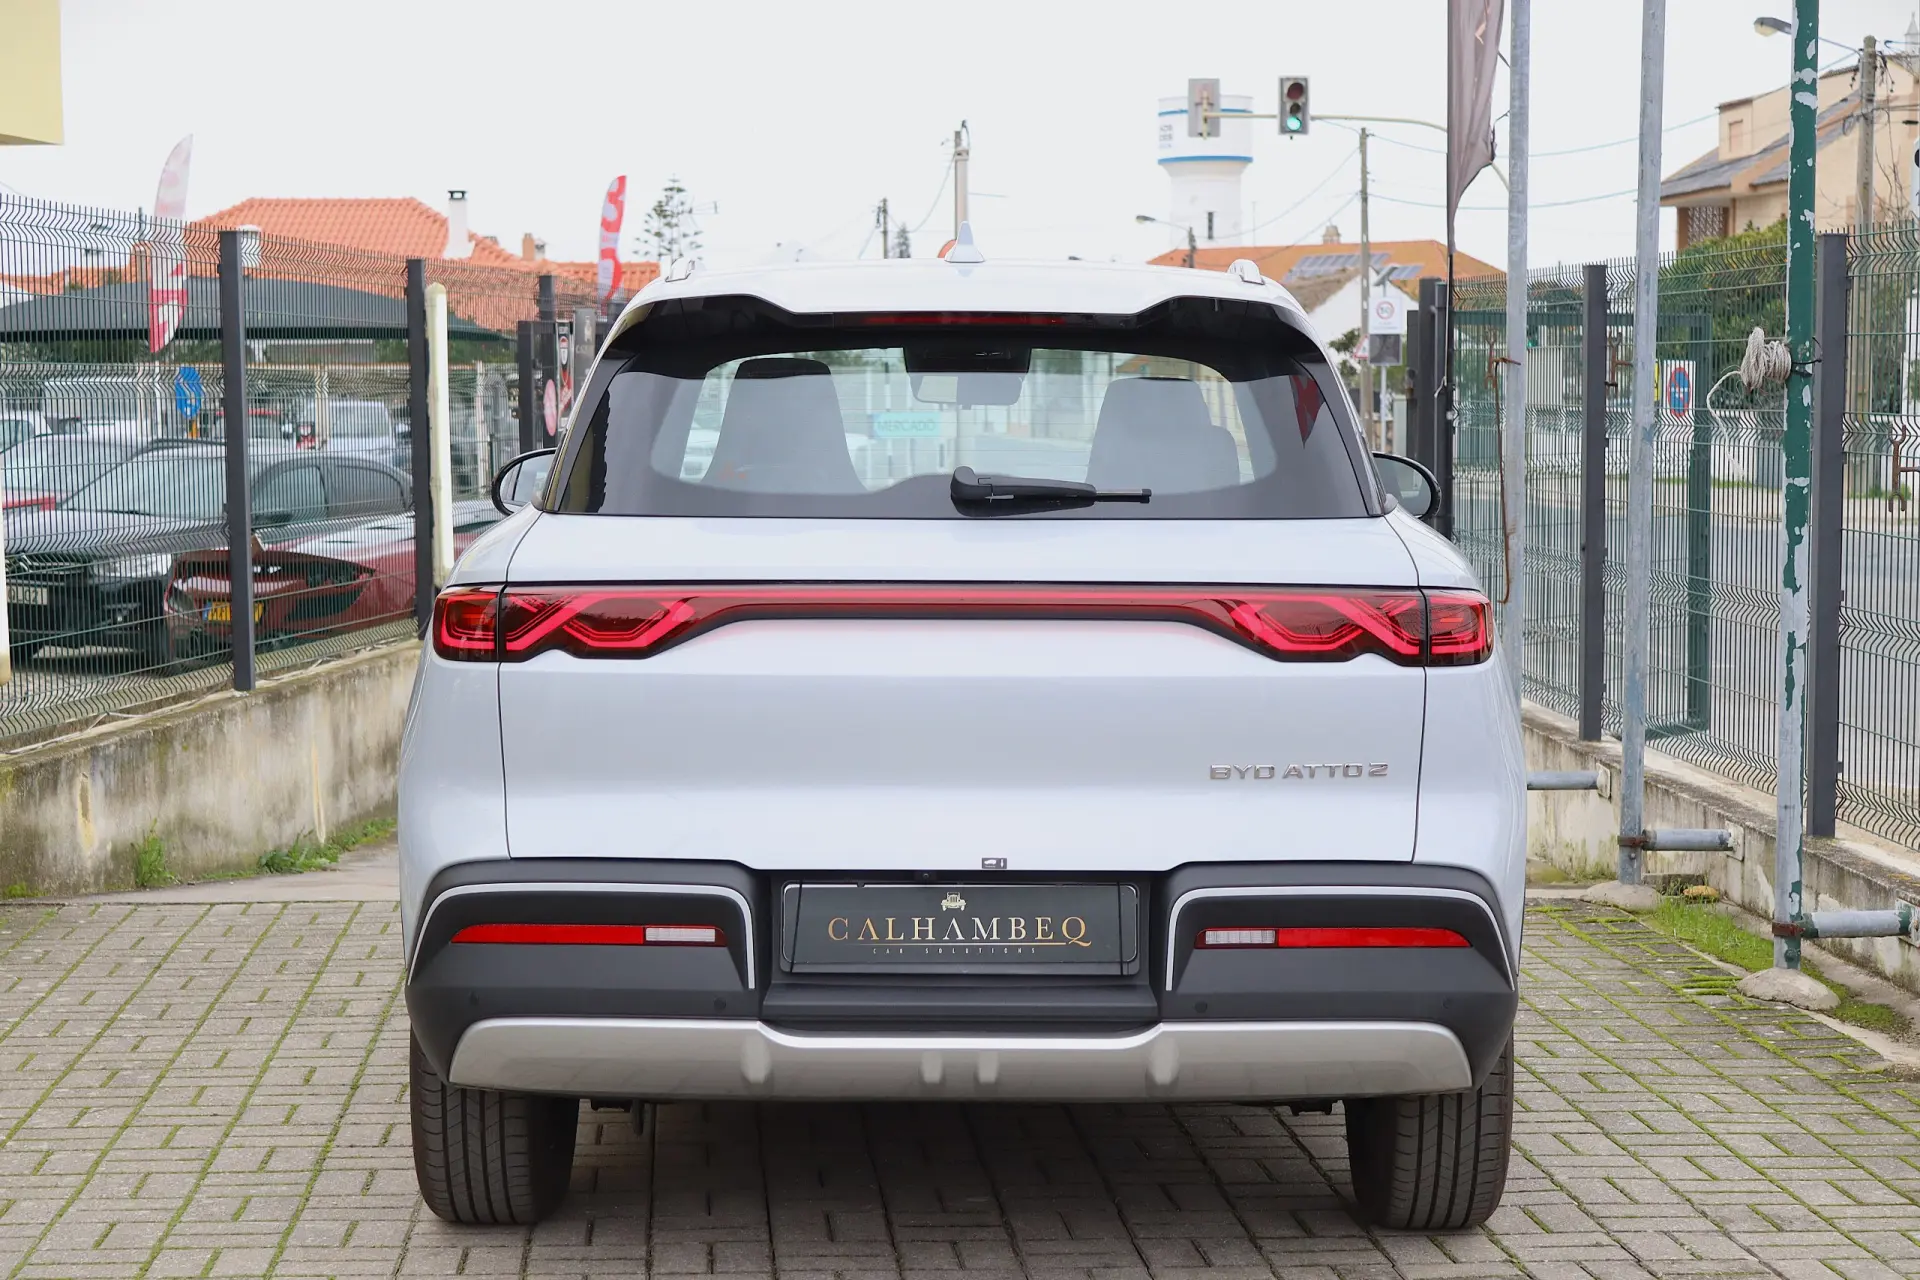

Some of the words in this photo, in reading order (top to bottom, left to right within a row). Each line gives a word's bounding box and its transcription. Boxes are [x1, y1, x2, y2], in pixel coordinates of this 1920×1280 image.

[877, 419, 936, 432] MERCADO
[1210, 764, 1275, 779] BYD
[1282, 763, 1363, 779] ATTO
[1368, 762, 1389, 777] 2
[828, 916, 1092, 947] CALHAMBEQ
